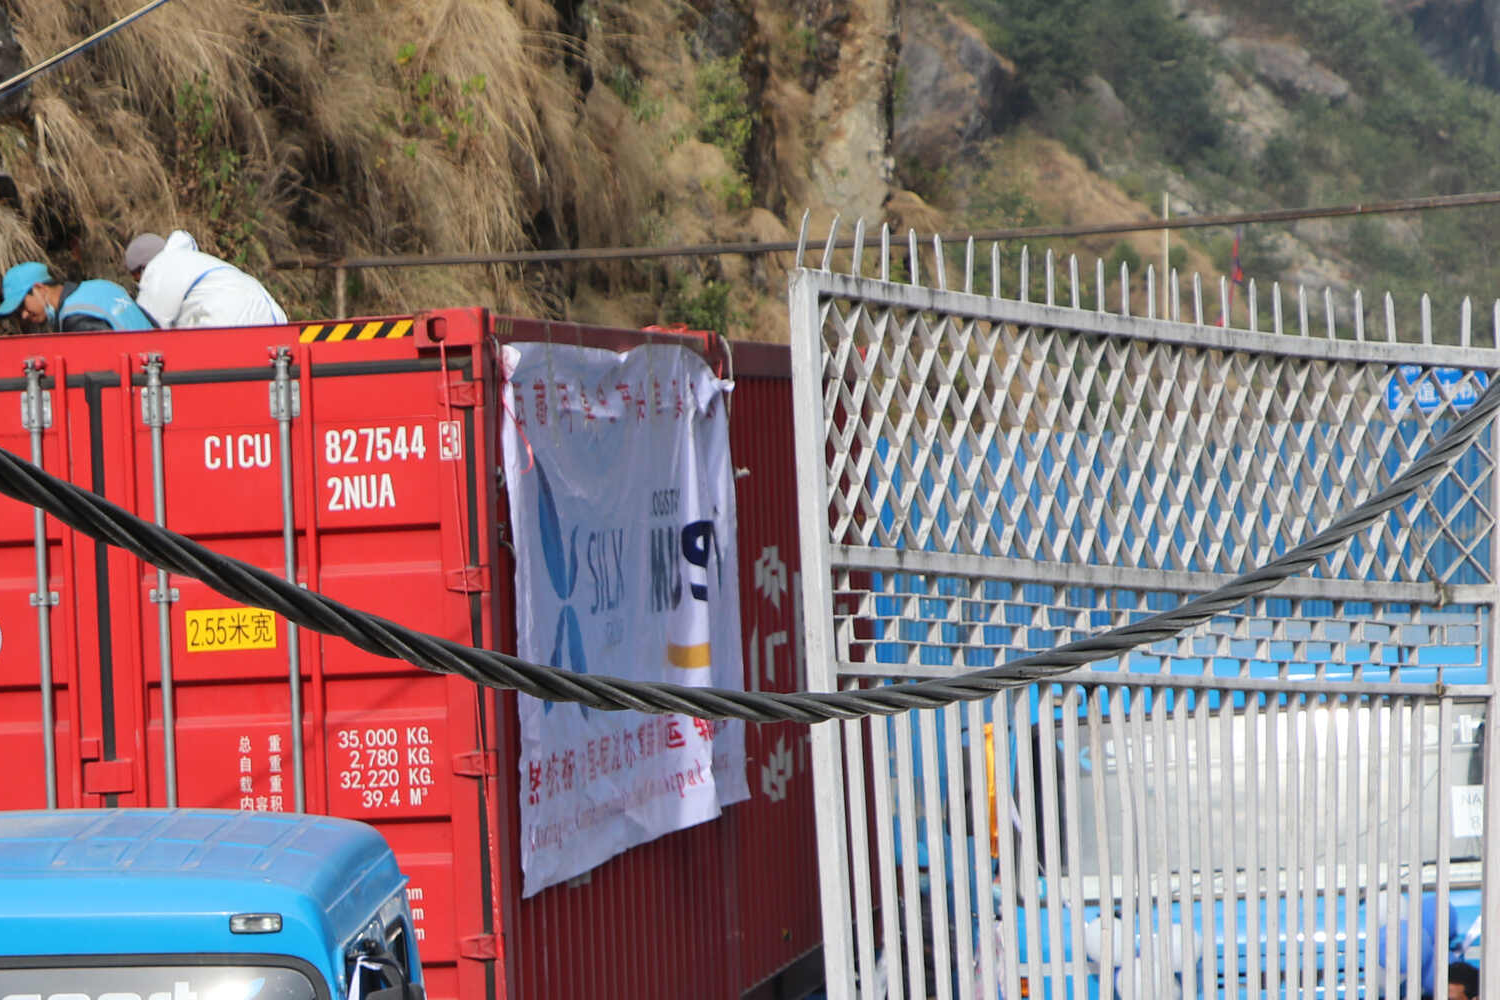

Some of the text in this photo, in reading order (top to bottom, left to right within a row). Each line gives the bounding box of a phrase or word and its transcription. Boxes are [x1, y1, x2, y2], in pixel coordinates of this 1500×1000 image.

[204, 423, 459, 469] CICU 827544 3
[326, 473, 396, 511] 2NUA
[189, 611, 274, 647] 2.55米宽
[337, 729, 398, 749] 35,000
[406, 727, 433, 745] KG.
[349, 749, 399, 770] 2,780
[407, 747, 434, 765] KG.
[339, 769, 400, 789] 32,220
[408, 768, 435, 786] KG.
[361, 789, 401, 808] 39.4
